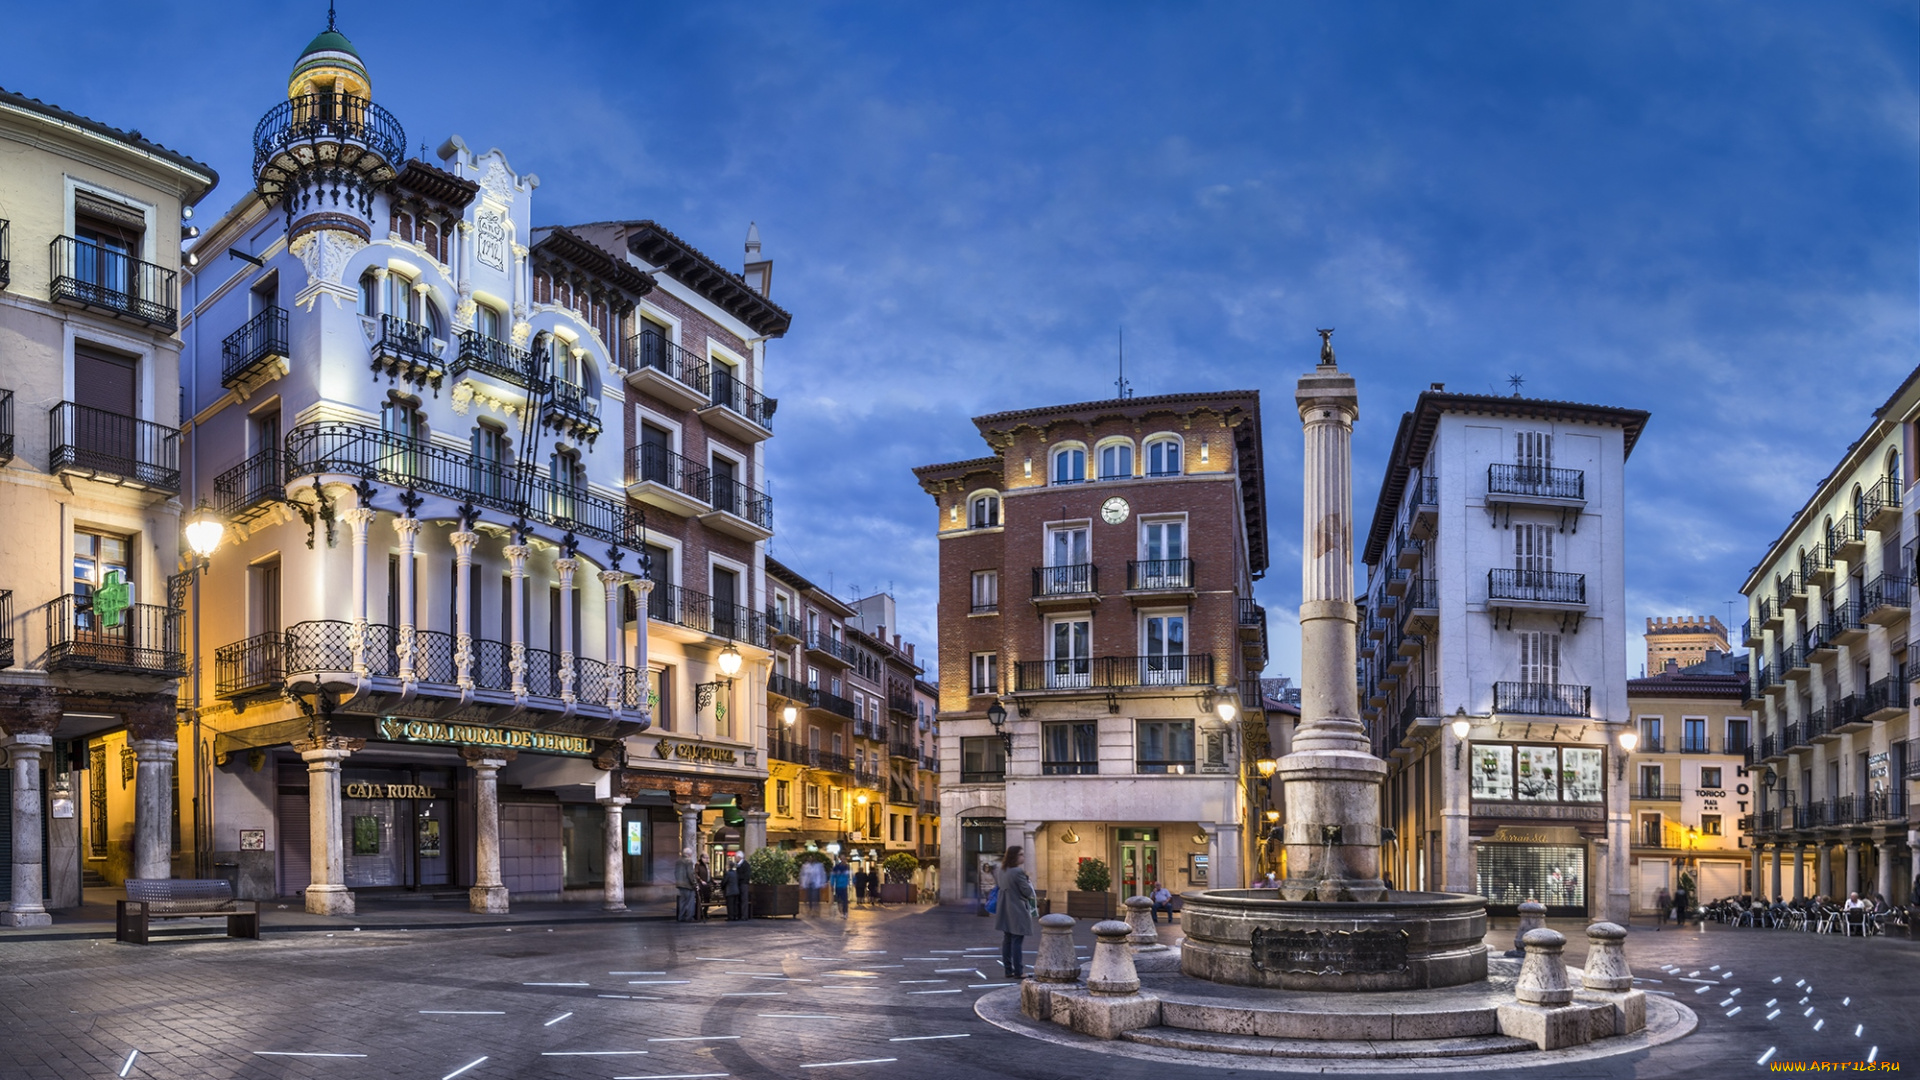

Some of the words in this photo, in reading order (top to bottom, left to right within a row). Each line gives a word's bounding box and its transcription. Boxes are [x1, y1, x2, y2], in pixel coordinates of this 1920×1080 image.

[408, 720, 451, 742] CAJA
[453, 724, 508, 746] RURAL
[510, 730, 532, 748] DE
[536, 733, 593, 754] TERUEL
[347, 783, 384, 799] CAJA
[387, 784, 436, 799] RURAL
[1695, 790, 1726, 798] TORICO
[1736, 765, 1749, 848] HOTEL
